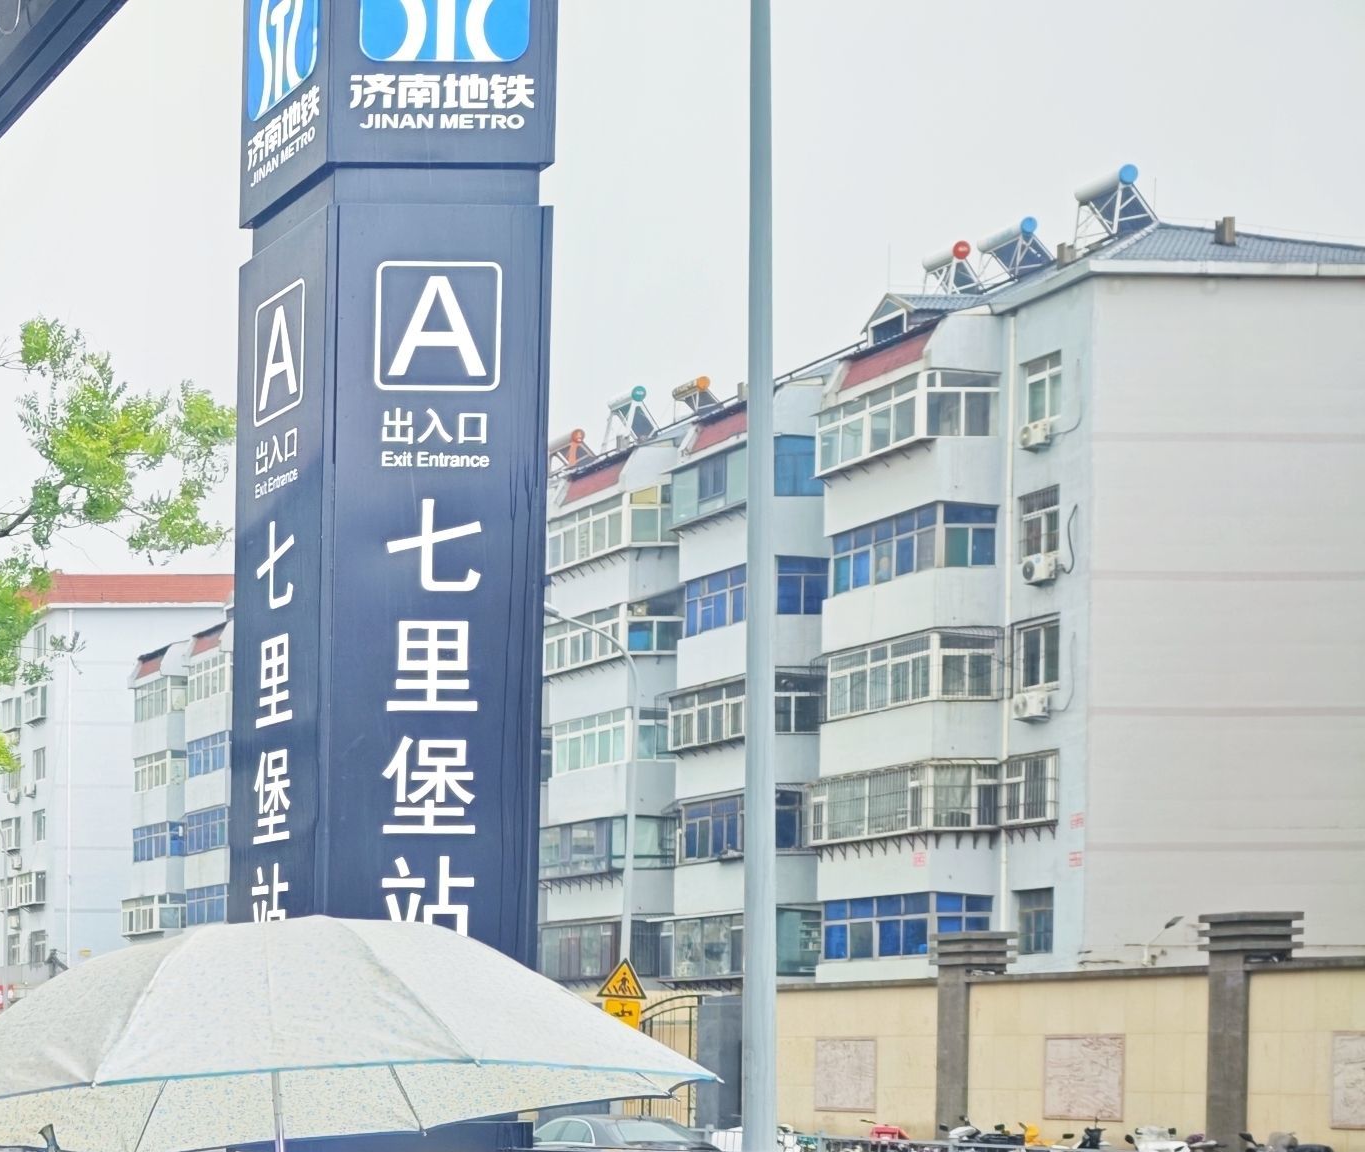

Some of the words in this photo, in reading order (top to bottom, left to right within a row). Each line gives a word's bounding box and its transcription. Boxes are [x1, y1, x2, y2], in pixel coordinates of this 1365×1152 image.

[350, 74, 535, 109] 济南地铁
[247, 85, 320, 172] 济南地铁
[360, 114, 434, 129] JINAN
[440, 114, 525, 129] METRO
[250, 154, 279, 187] JINAN
[280, 126, 316, 164] METRO
[387, 275, 487, 377] A
[258, 305, 298, 412] A
[381, 407, 488, 444] 出入口
[255, 428, 298, 475] 出入口
[381, 450, 413, 467] Exit
[417, 450, 490, 467] Entrance
[255, 481, 267, 499] Exit
[268, 468, 298, 492] Entrance
